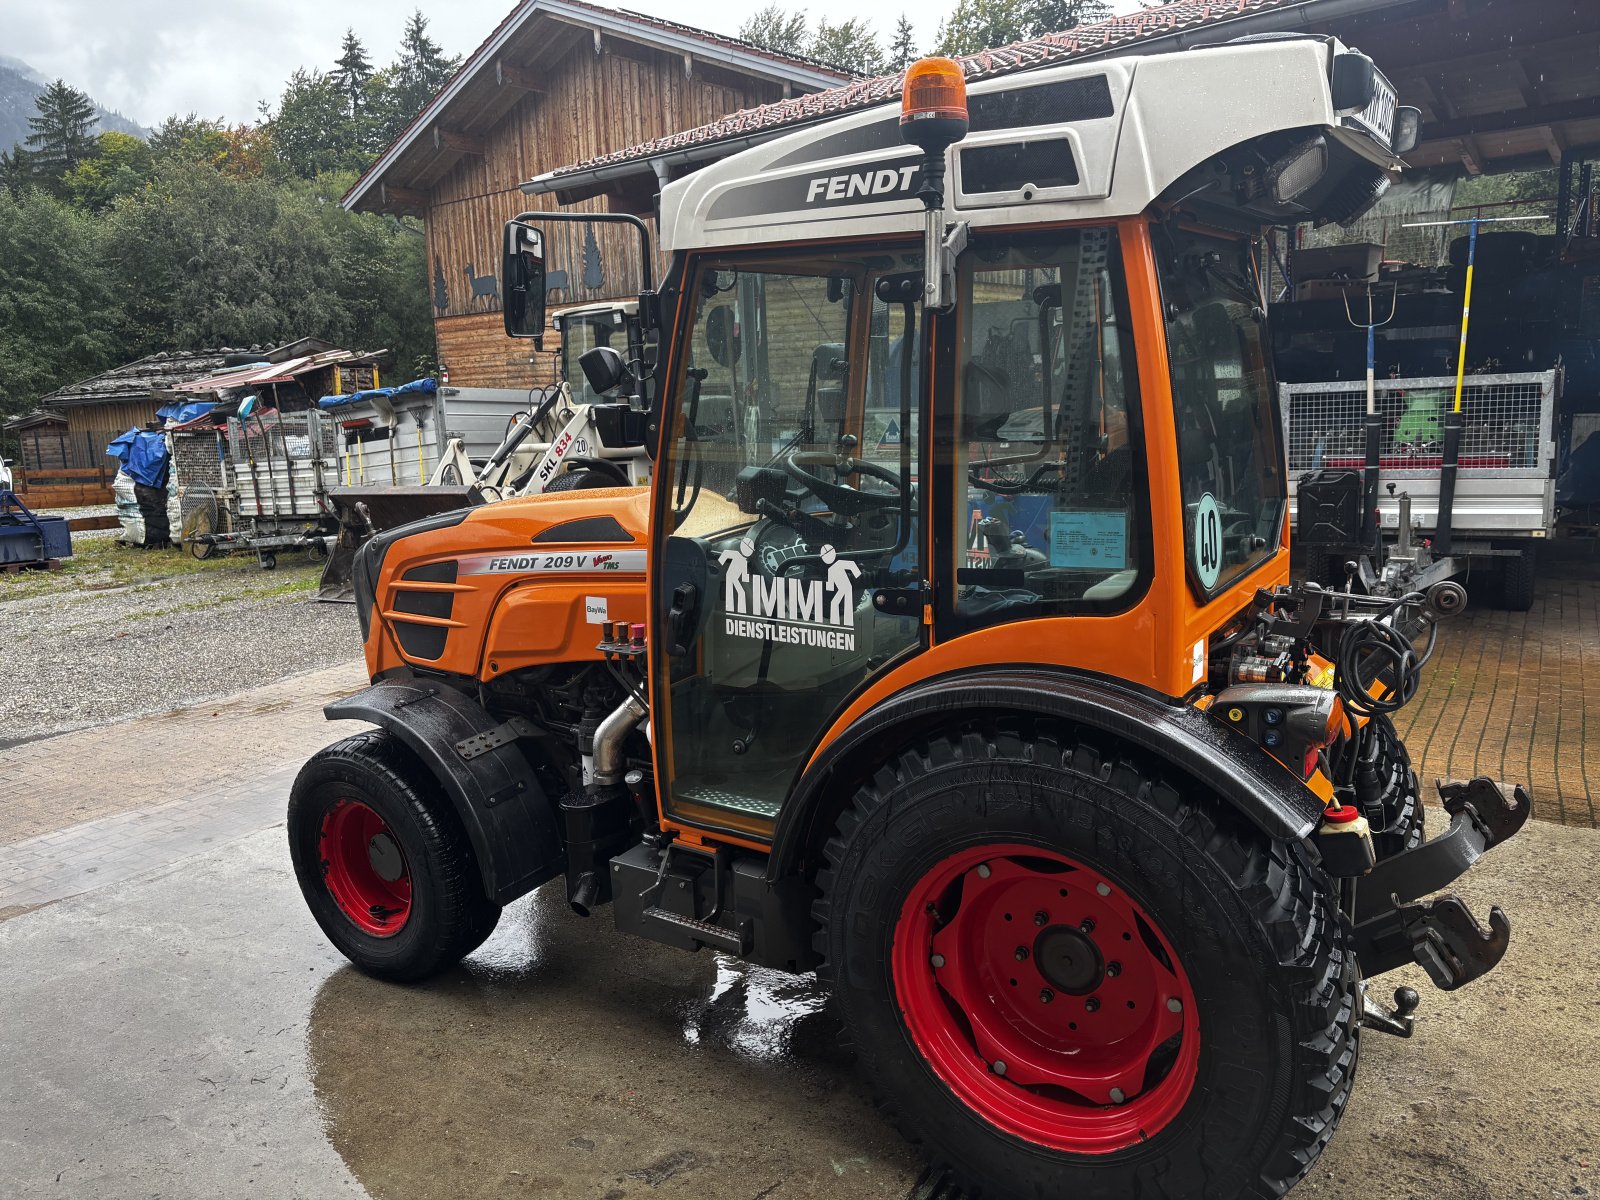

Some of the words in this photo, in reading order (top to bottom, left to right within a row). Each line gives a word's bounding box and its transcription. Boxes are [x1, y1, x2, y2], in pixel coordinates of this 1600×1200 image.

[805, 165, 920, 203] FENDT
[540, 458, 558, 482] SKL
[555, 431, 572, 457] 834
[576, 439, 586, 453] 20
[1201, 509, 1218, 573] 40
[489, 557, 539, 571] FENDT
[543, 555, 574, 569] 209
[576, 555, 588, 568] V
[603, 561, 620, 570] TMS
[586, 605, 607, 615] BayWa
[752, 574, 824, 624] MM
[725, 618, 855, 652] DIENSTLEISTUNGEN
